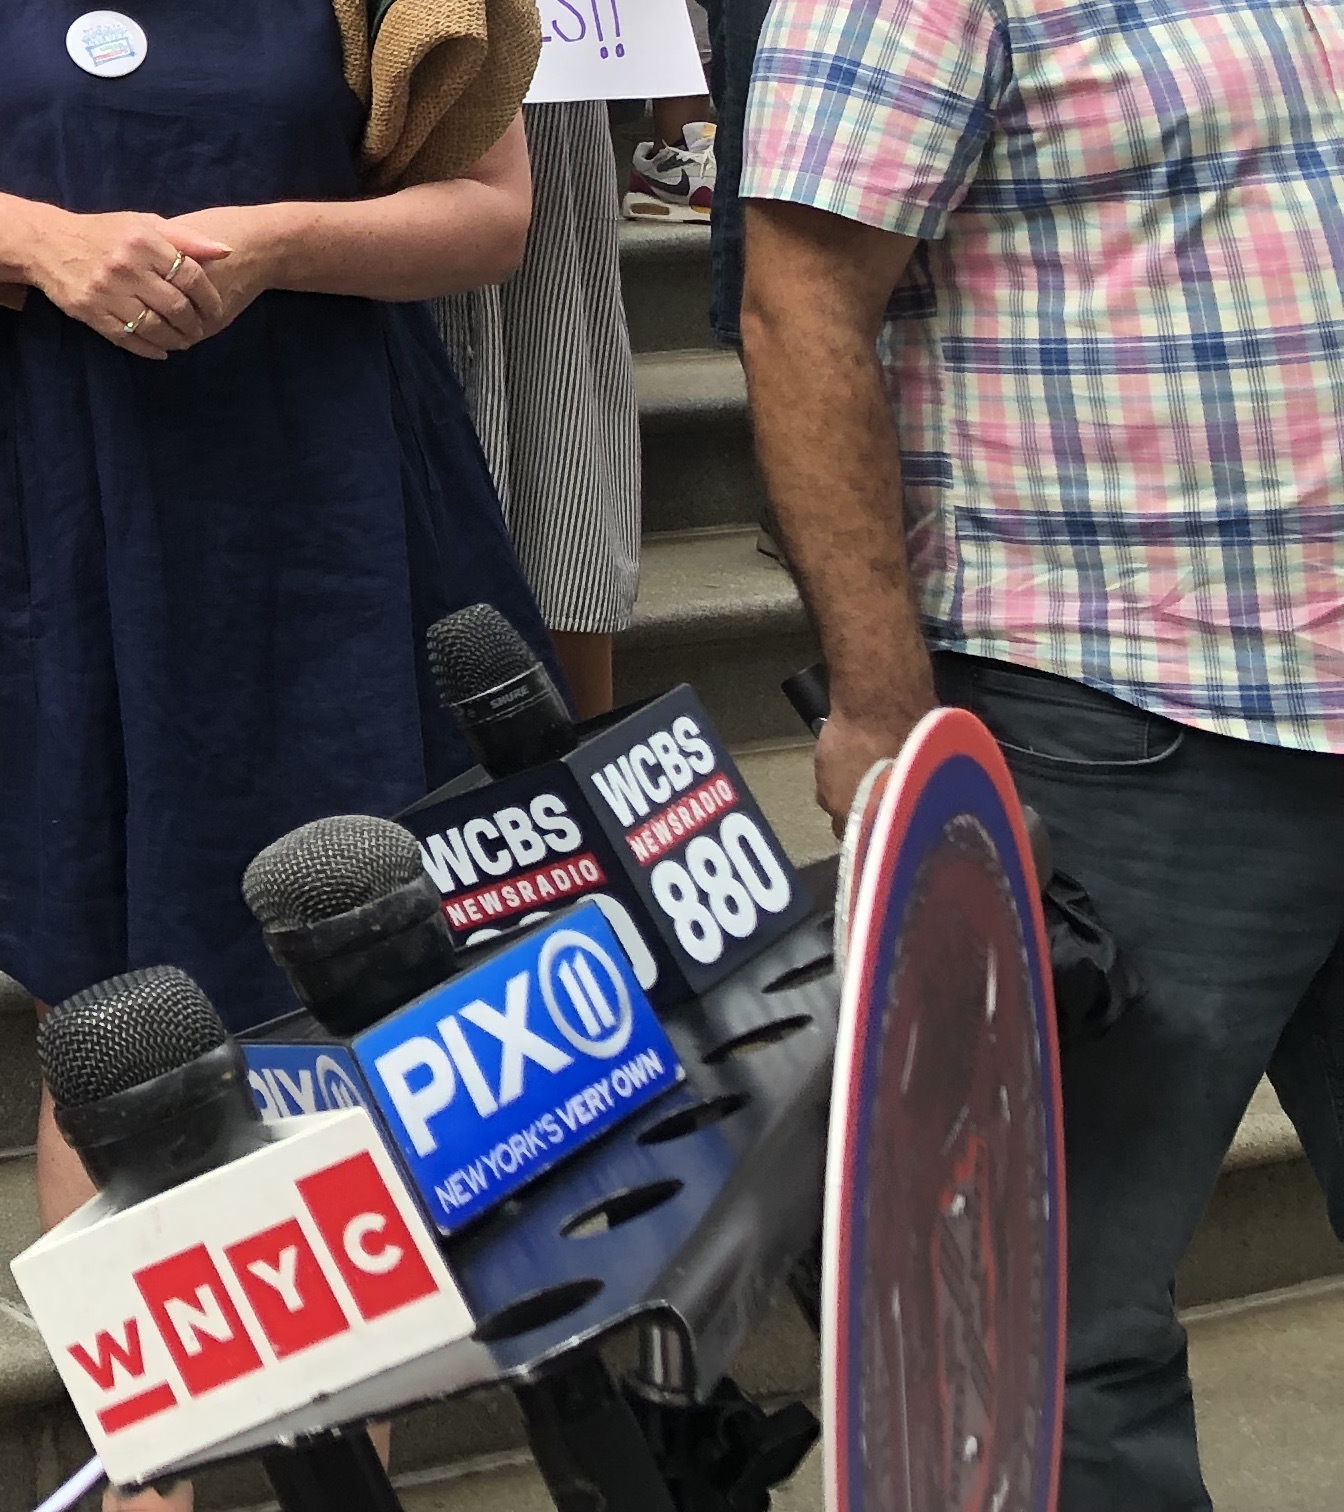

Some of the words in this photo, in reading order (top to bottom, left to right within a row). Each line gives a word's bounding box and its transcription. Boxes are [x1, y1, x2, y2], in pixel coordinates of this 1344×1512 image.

[591, 715, 716, 828] WCBS
[629, 778, 735, 862] NEWSRADIO
[420, 792, 583, 893] WCBS
[446, 858, 601, 928] NEWSRADIO
[650, 811, 792, 965] 880
[433, 1159, 489, 1214] NEW
[483, 1113, 564, 1180] YORK'S
[555, 1078, 616, 1133] VERY
[610, 1047, 664, 1098] OWN
[68, 1212, 410, 1394] WNYC
